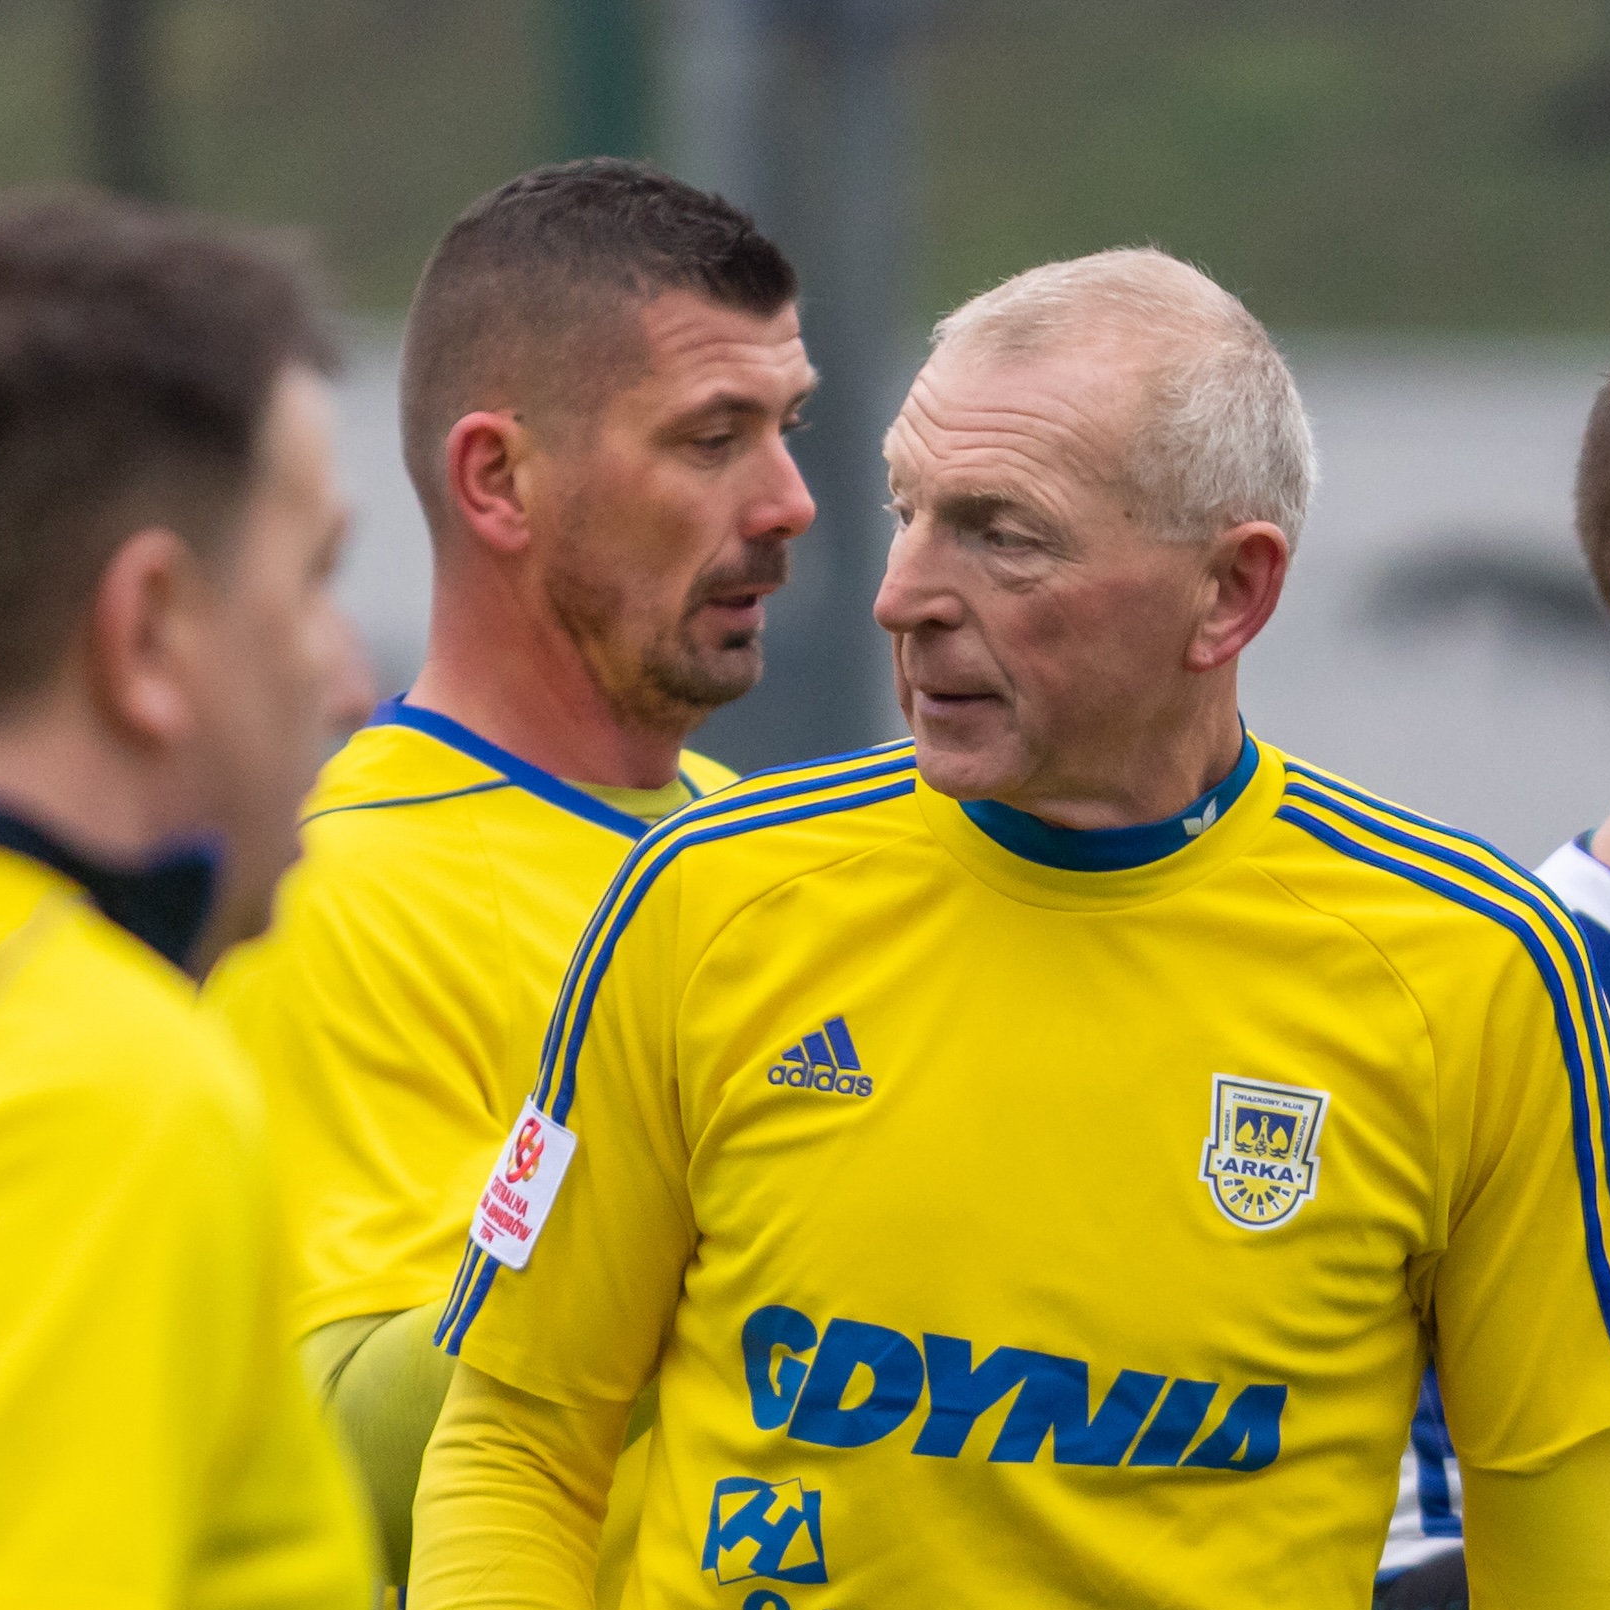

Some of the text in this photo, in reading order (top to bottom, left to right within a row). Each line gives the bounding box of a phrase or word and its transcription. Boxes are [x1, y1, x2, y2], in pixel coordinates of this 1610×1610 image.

[767, 1060, 873, 1097] adidas
[1282, 1102, 1304, 1111] KLUB
[1293, 1115, 1309, 1160] SPORTOWY
[1221, 1157, 1295, 1183] ARKA
[741, 1304, 1289, 1472] GDYNIA
